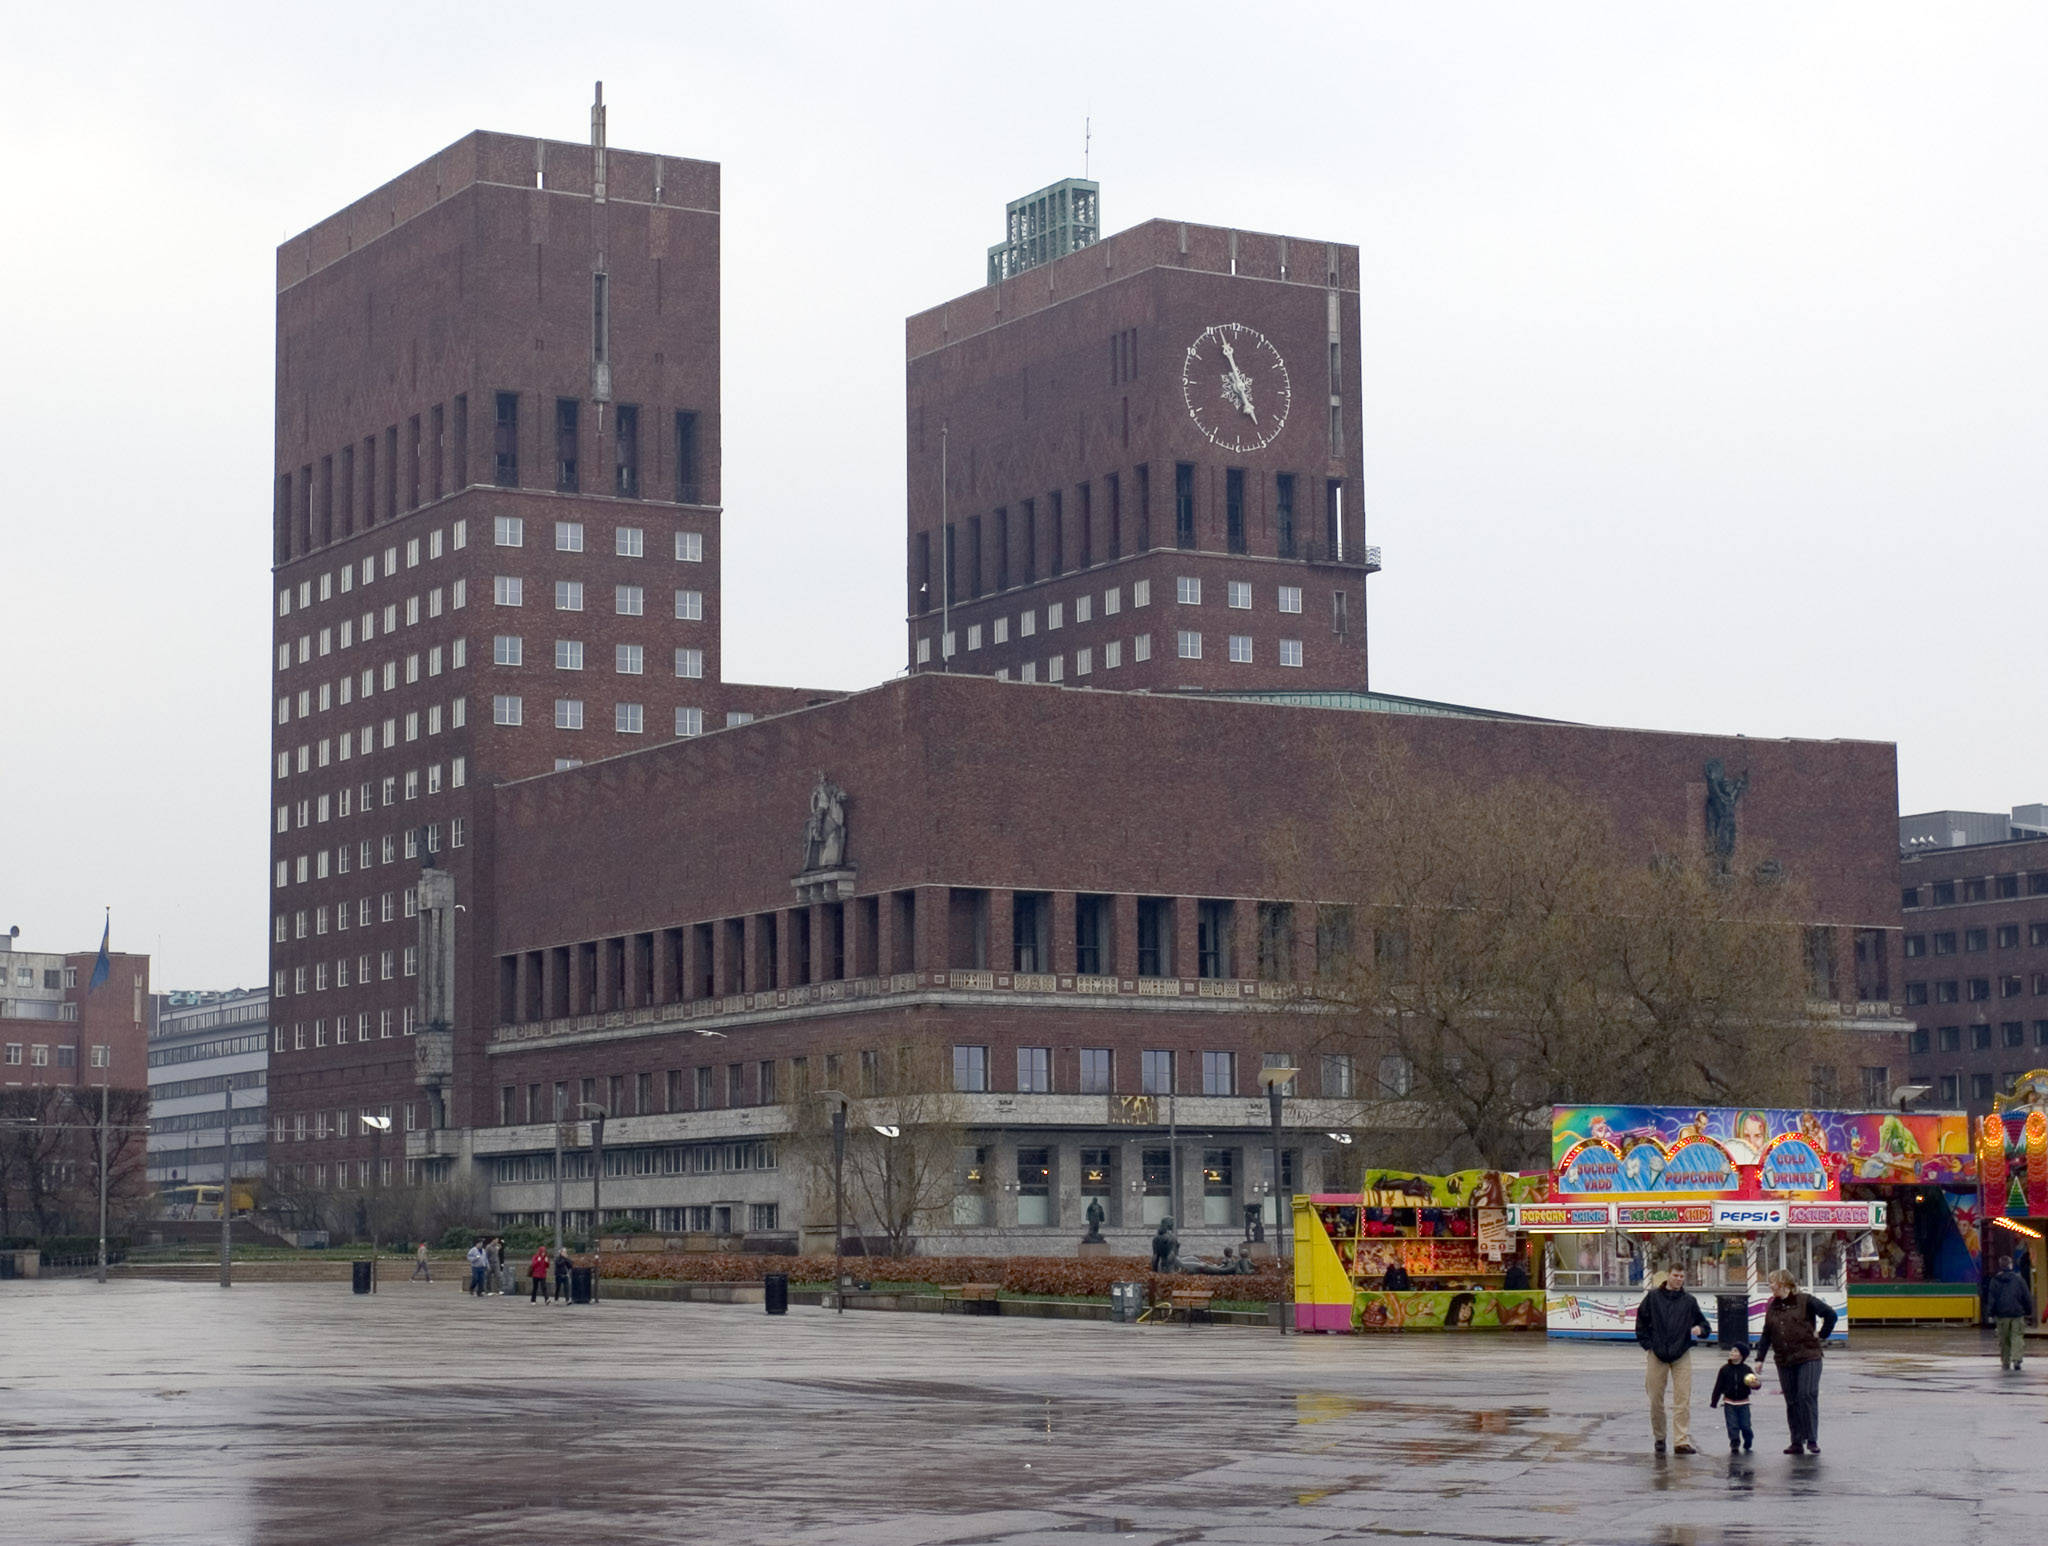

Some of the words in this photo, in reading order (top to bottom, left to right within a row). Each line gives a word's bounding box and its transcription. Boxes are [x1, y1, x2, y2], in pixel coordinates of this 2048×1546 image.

[1206, 326, 1214, 335] 11
[1232, 323, 1240, 331] 12
[1259, 334, 1264, 343] 1
[1187, 347, 1196, 356] 10
[1278, 359, 1284, 367] 2
[1182, 378, 1188, 386] 9
[1286, 389, 1291, 398] 3
[1279, 420, 1285, 428] 4
[1235, 444, 1242, 453] 6
[1261, 440, 1267, 448] 5
[1777, 1154, 1805, 1165] COLD
[1577, 1163, 1618, 1176] SOCKER
[1665, 1171, 1725, 1184] POPCORN
[1773, 1172, 1815, 1184] DRINKS
[1584, 1179, 1612, 1191] VADD
[1520, 1210, 1566, 1224] POPCORN
[1571, 1210, 1608, 1224] DRINKS
[1631, 1209, 1645, 1221] ICE
[1646, 1208, 1679, 1221] CREAM
[1684, 1207, 1711, 1222] CHIPS
[1720, 1211, 1768, 1222] PEPSI
